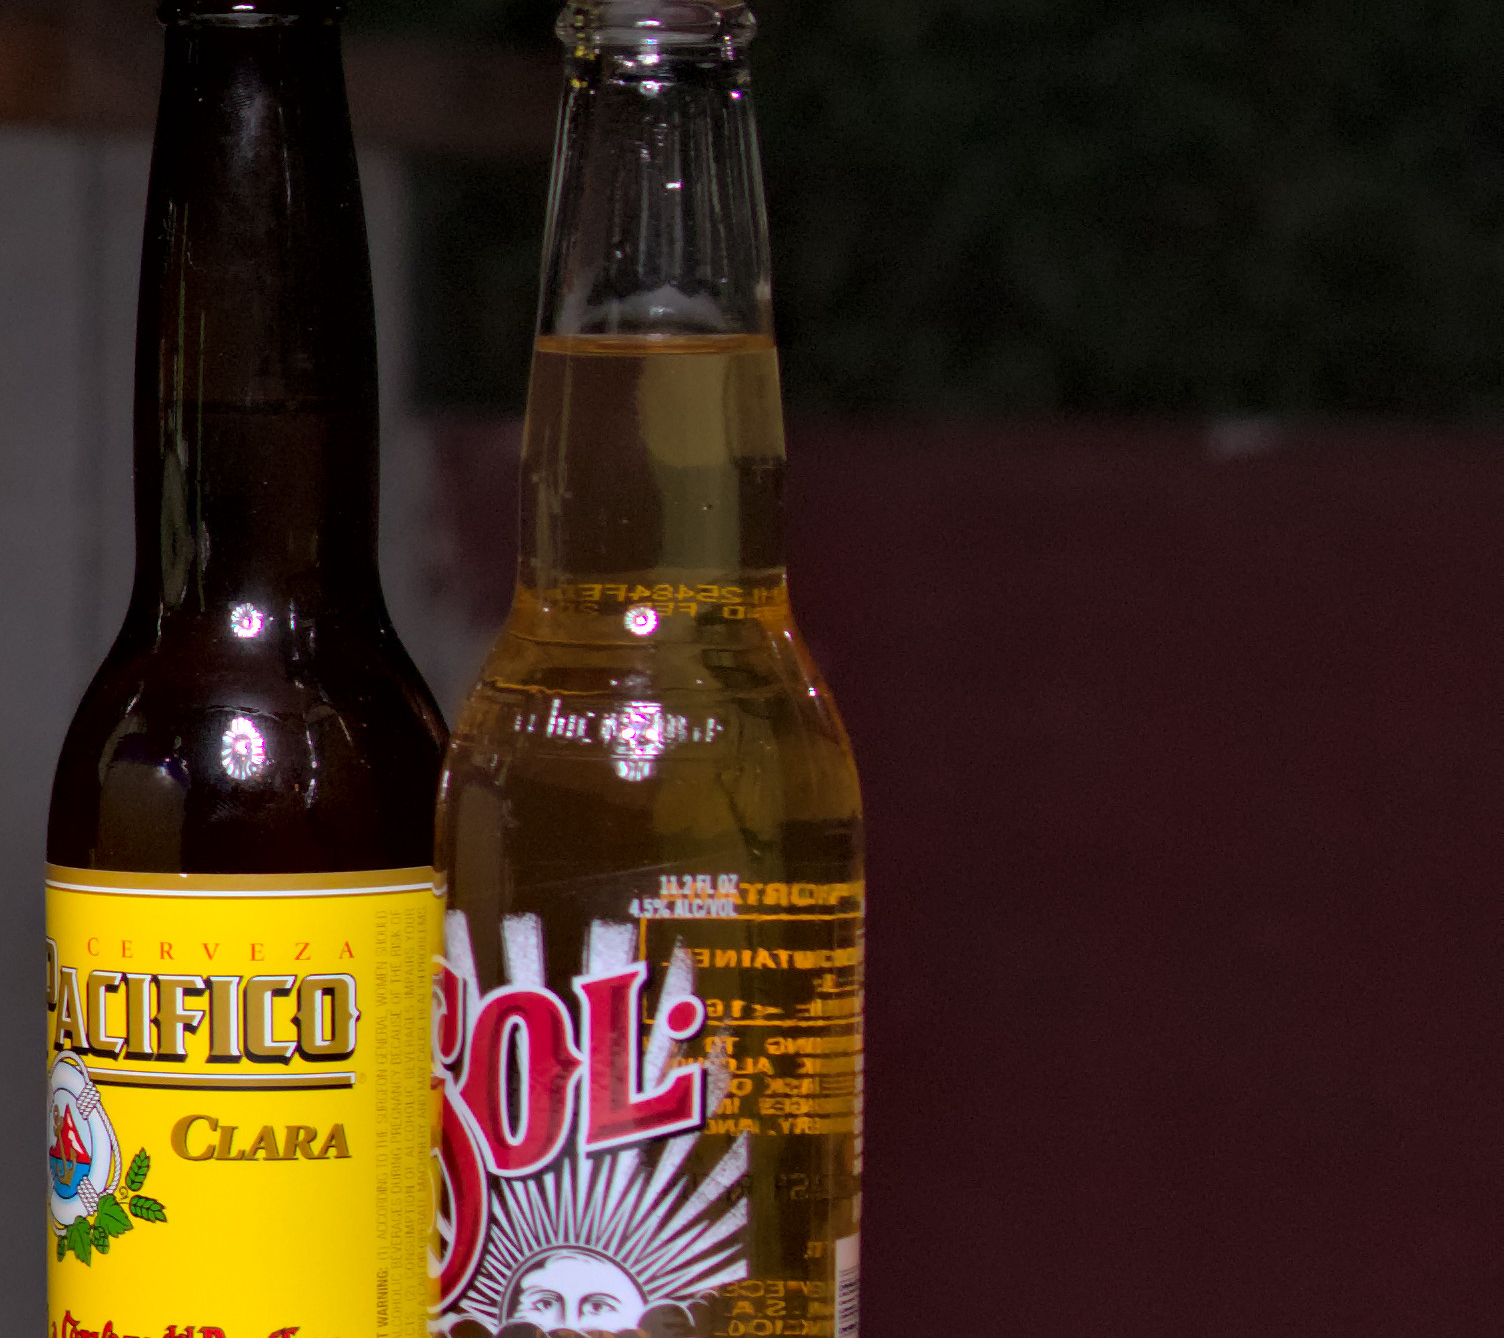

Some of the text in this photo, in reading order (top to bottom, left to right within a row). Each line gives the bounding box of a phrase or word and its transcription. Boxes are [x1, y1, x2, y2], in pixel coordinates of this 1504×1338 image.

[695, 873, 715, 895] FL
[717, 873, 739, 895] OZ
[87, 937, 356, 962] CERVEZA
[375, 962, 387, 1007] WOMEN
[376, 1131, 388, 1148] THE
[376, 1153, 387, 1168] TO
[391, 1148, 402, 1194] DURING
[376, 1172, 388, 1240] ACCORDING
[391, 1198, 403, 1269] BEVERAGES
[377, 1268, 389, 1328] WARNING:
